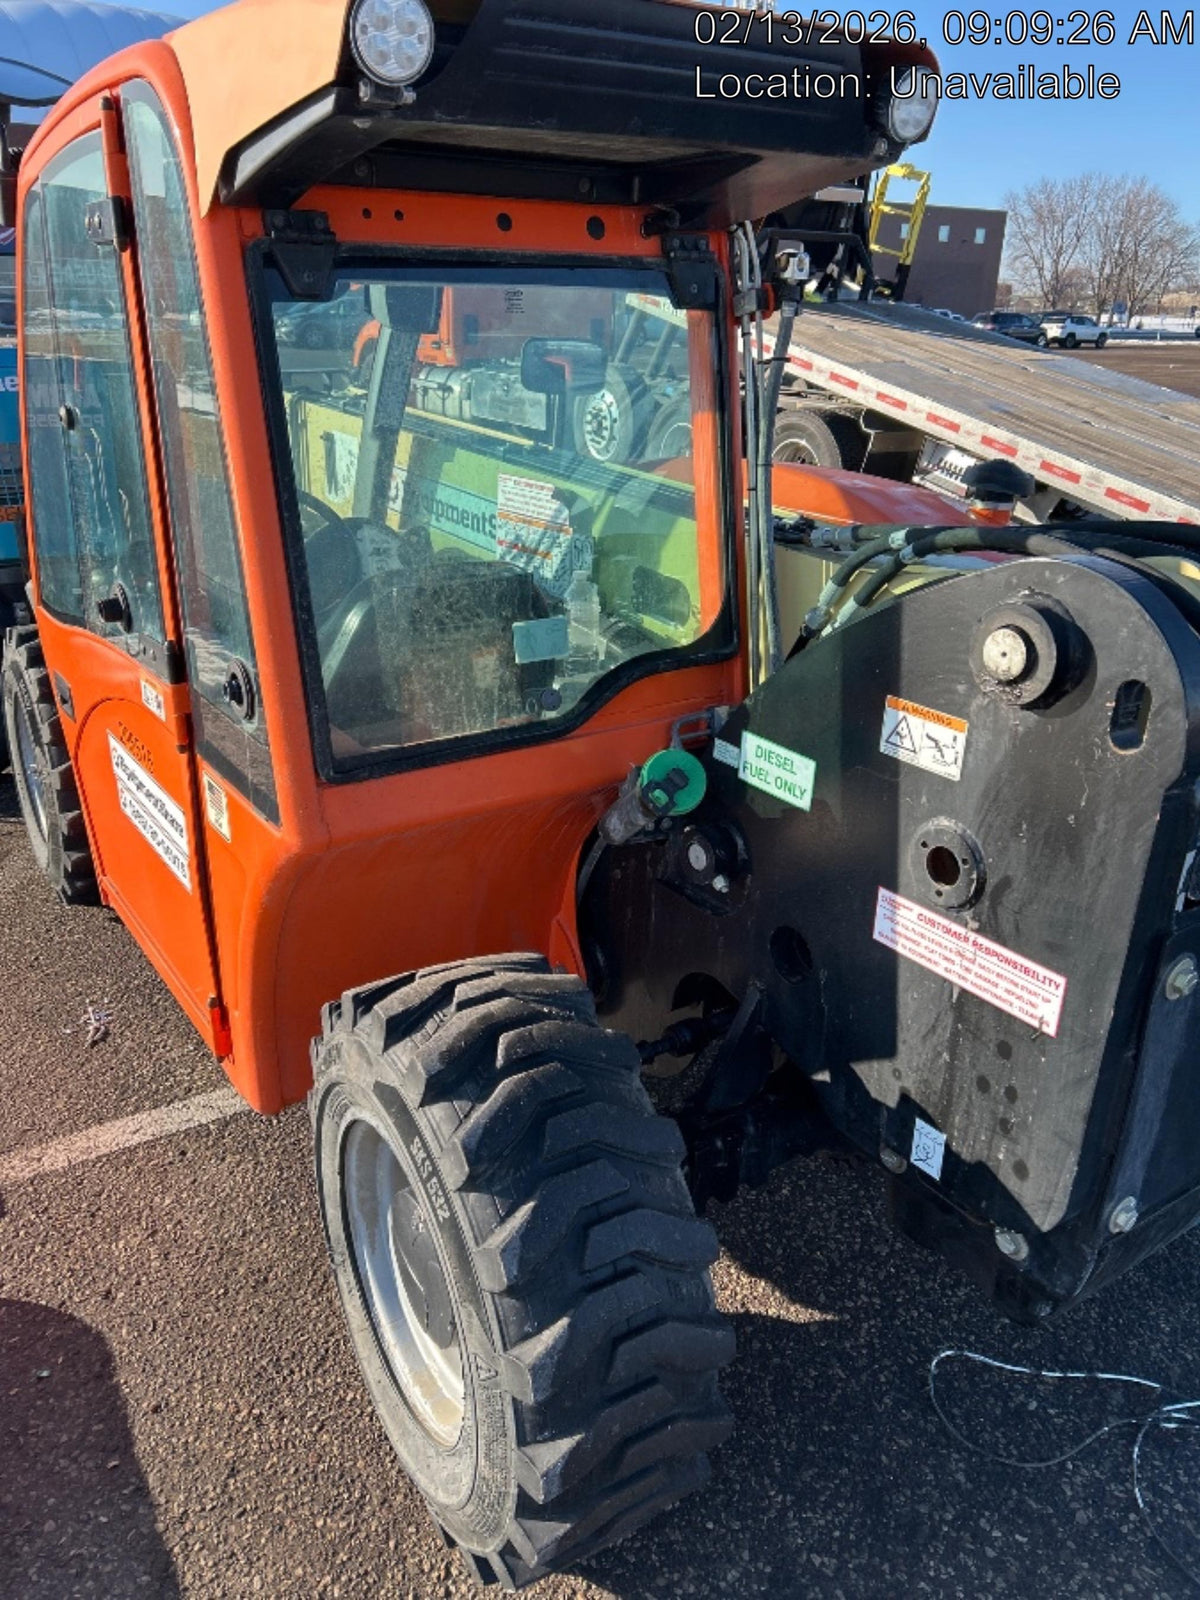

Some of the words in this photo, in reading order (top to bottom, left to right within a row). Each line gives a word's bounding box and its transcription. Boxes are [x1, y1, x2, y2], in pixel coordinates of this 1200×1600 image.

[742, 760, 771, 785] FUEL
[774, 776, 807, 801] ONLY
[755, 744, 798, 776] DIESEL
[916, 911, 970, 945] CUSTOMER
[971, 936, 1061, 991] RESPONSIBILITY
